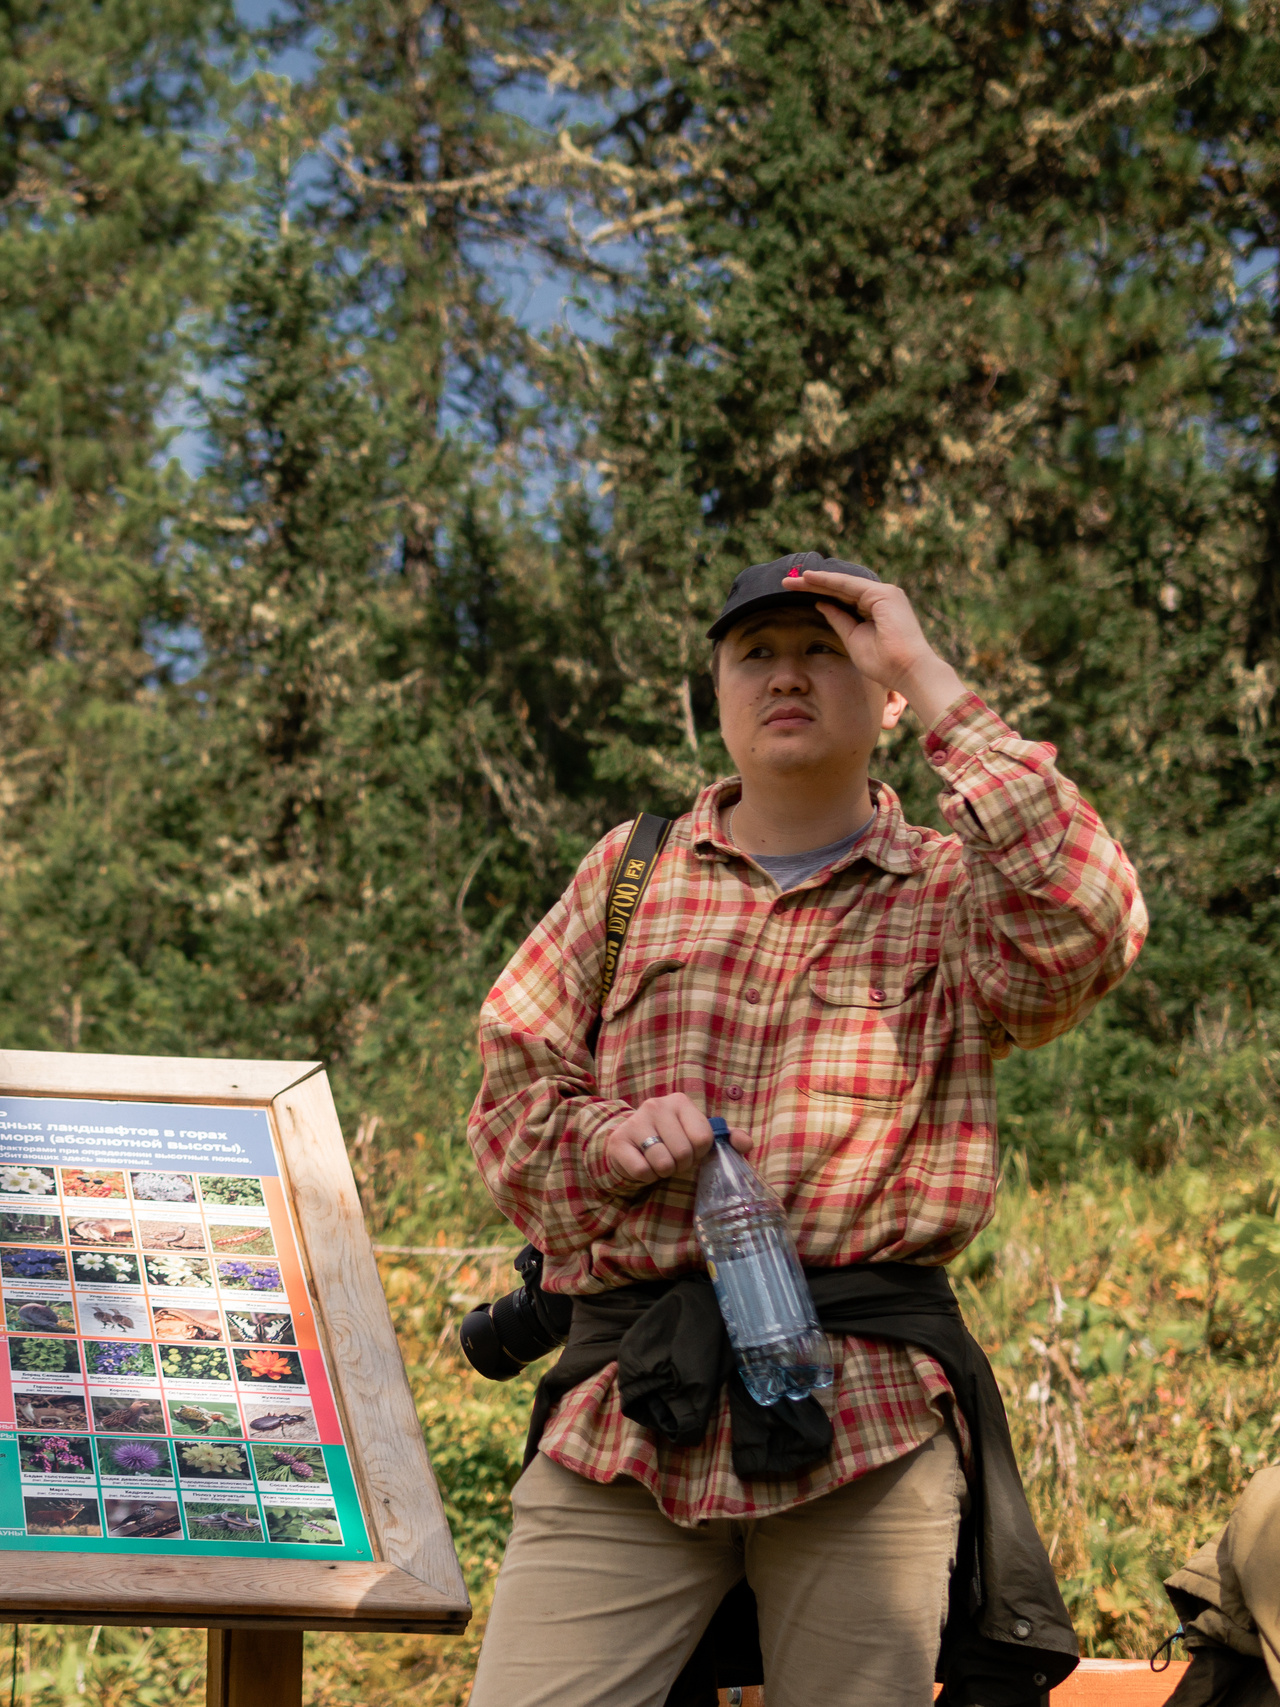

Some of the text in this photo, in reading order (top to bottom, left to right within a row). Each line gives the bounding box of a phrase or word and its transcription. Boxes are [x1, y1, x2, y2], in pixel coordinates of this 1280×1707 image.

[608, 883, 639, 935] D700
[625, 859, 645, 879] FX
[46, 1121, 159, 1138] ландшафтов
[163, 1128, 175, 1137] в
[179, 1129, 227, 1141] горах
[0, 1133, 44, 1146] моря
[49, 1133, 162, 1151] (абсолютной
[58, 1147, 78, 1156] при
[81, 1148, 152, 1160] определении
[154, 1152, 209, 1161] высотных
[62, 1155, 93, 1164] здесь
